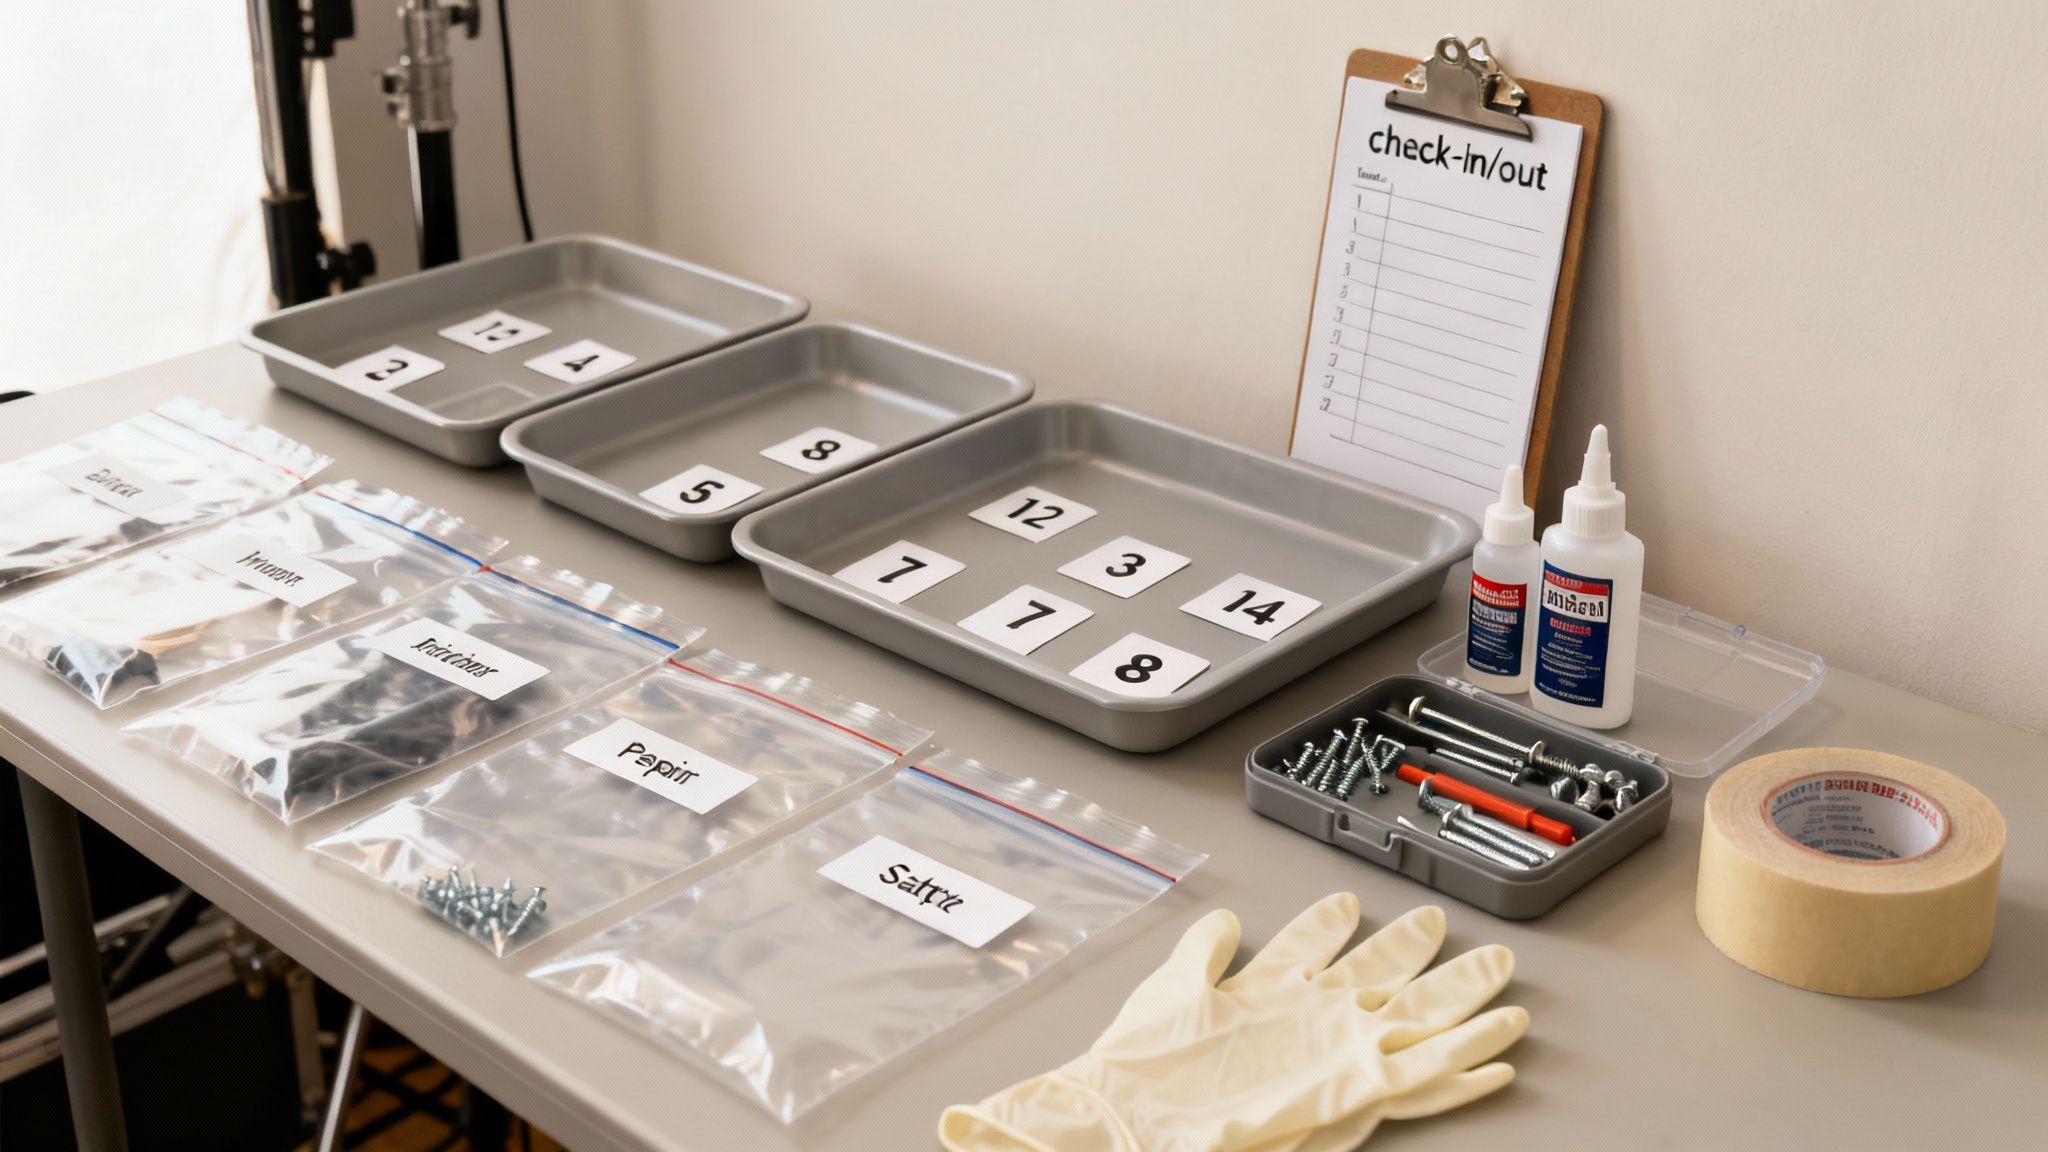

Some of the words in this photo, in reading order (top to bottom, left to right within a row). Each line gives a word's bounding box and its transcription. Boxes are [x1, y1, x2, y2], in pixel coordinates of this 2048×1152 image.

[1369, 123, 1548, 191] check-in/out
[801, 440, 841, 461] 8
[679, 480, 725, 504] 5
[1006, 497, 1065, 530] 12
[877, 555, 928, 584] 7
[1105, 553, 1147, 578] 3
[1006, 600, 1057, 630] 7
[1222, 590, 1286, 626] 14
[1114, 653, 1163, 684] 8
